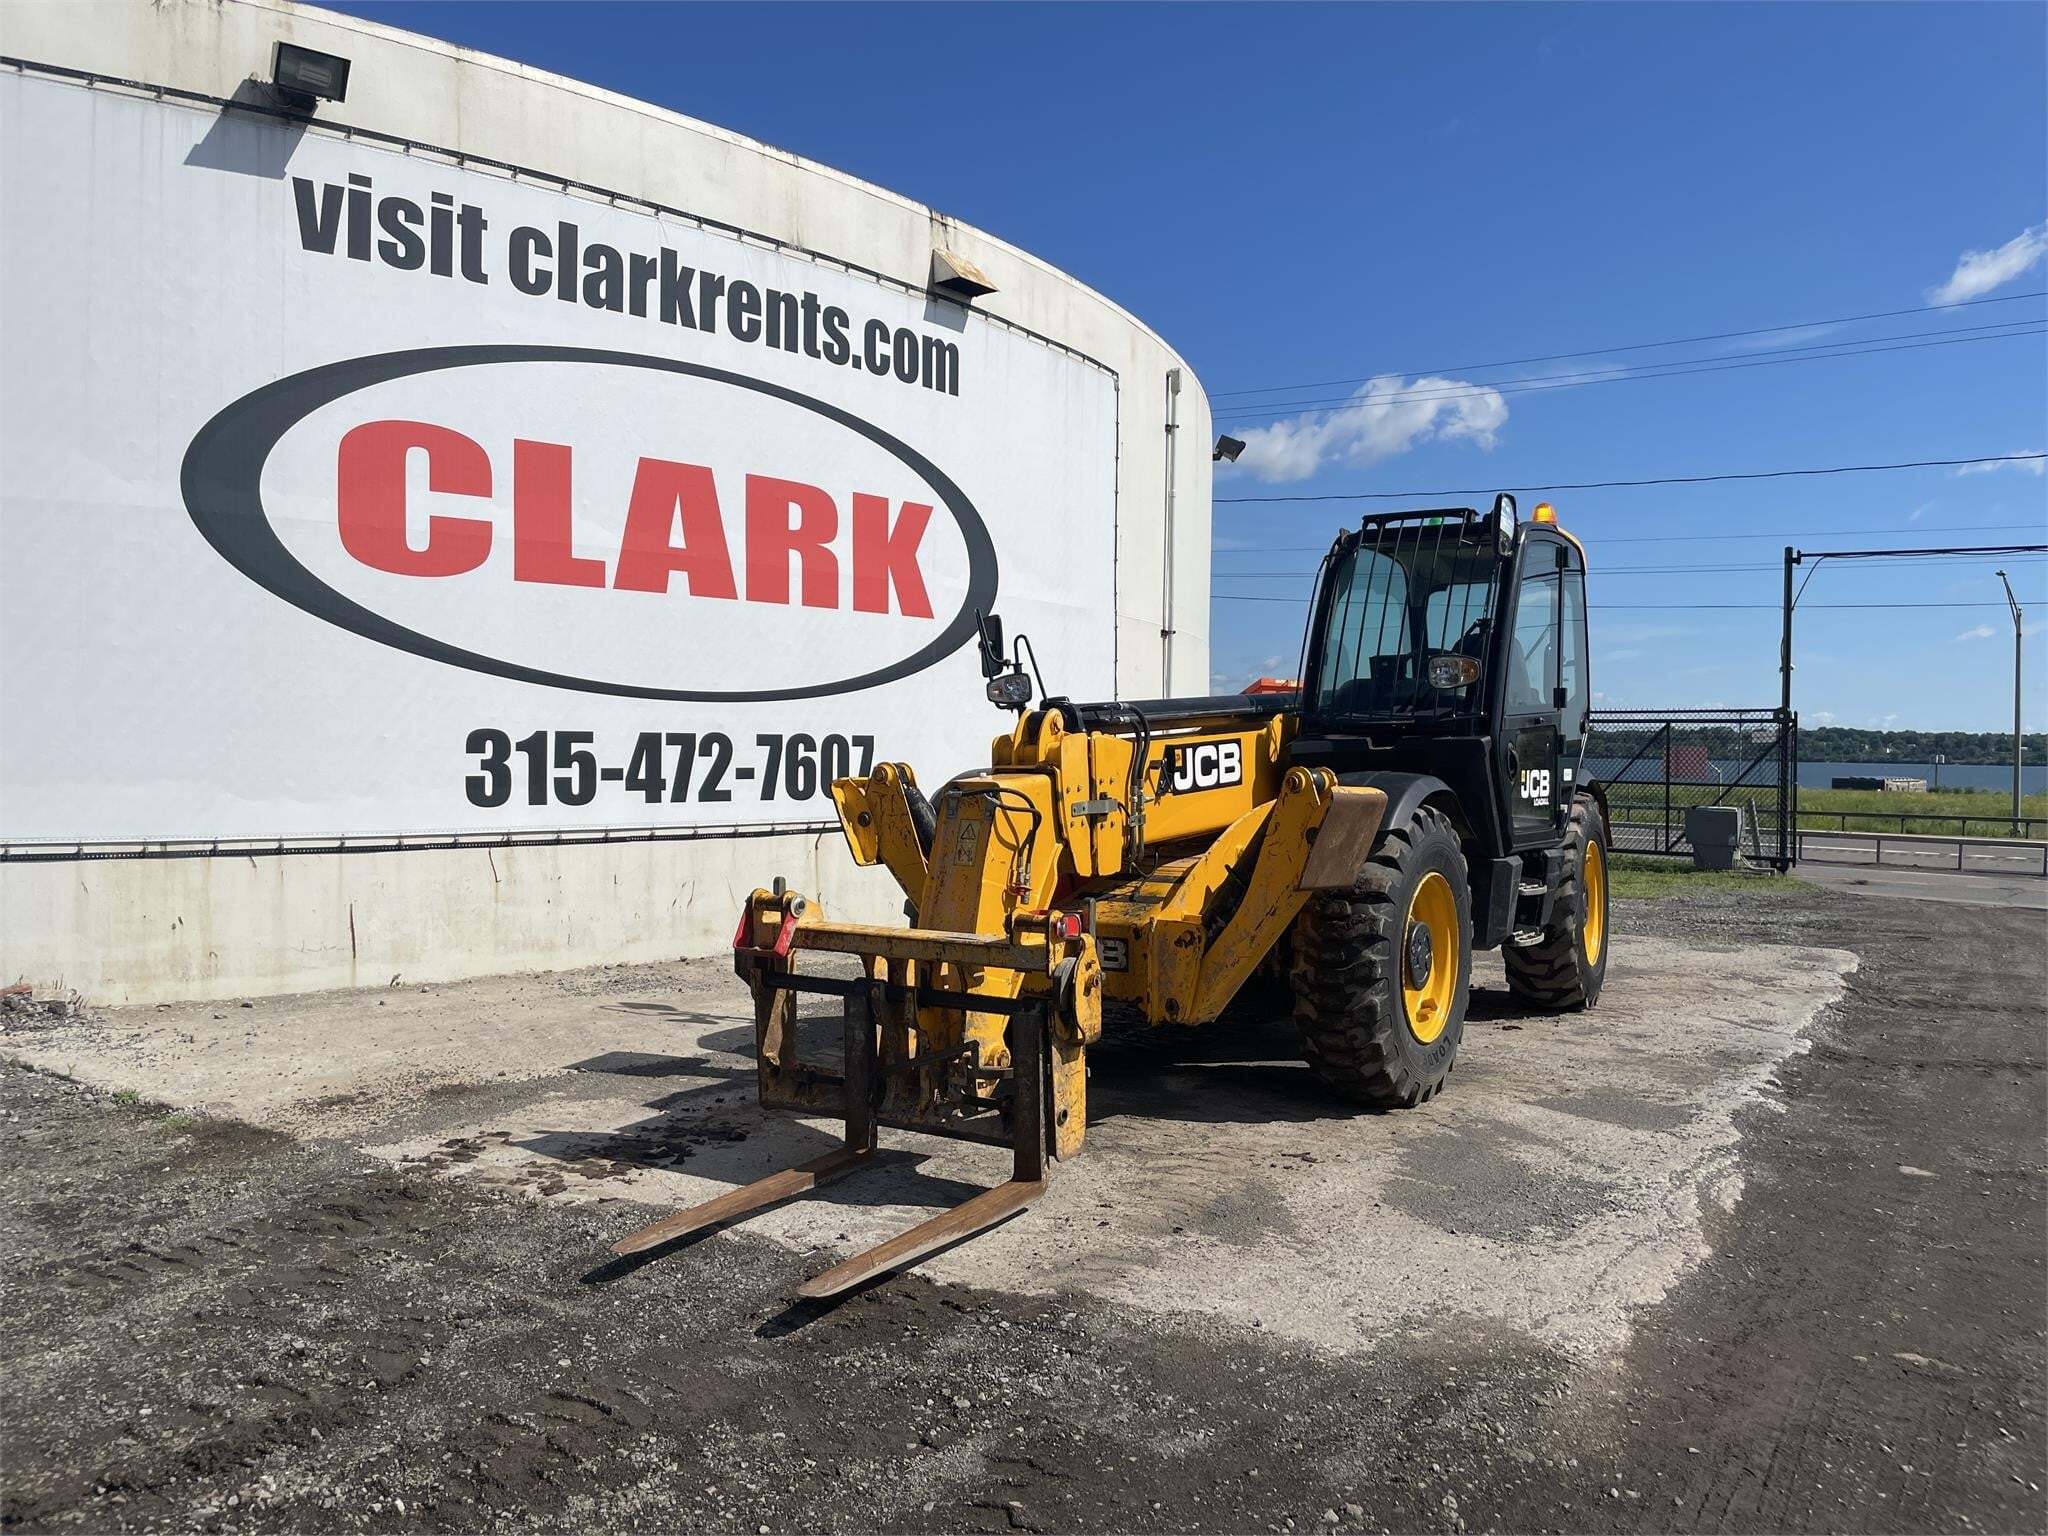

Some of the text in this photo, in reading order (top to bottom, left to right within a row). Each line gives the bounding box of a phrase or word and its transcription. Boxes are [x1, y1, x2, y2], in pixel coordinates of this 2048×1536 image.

[292, 173, 960, 397] visit clarkrents.com
[337, 418, 935, 620] CLARK
[464, 727, 875, 808] 315-472-7607
[1173, 742, 1241, 791] JCB
[1520, 769, 1550, 799] JCB
